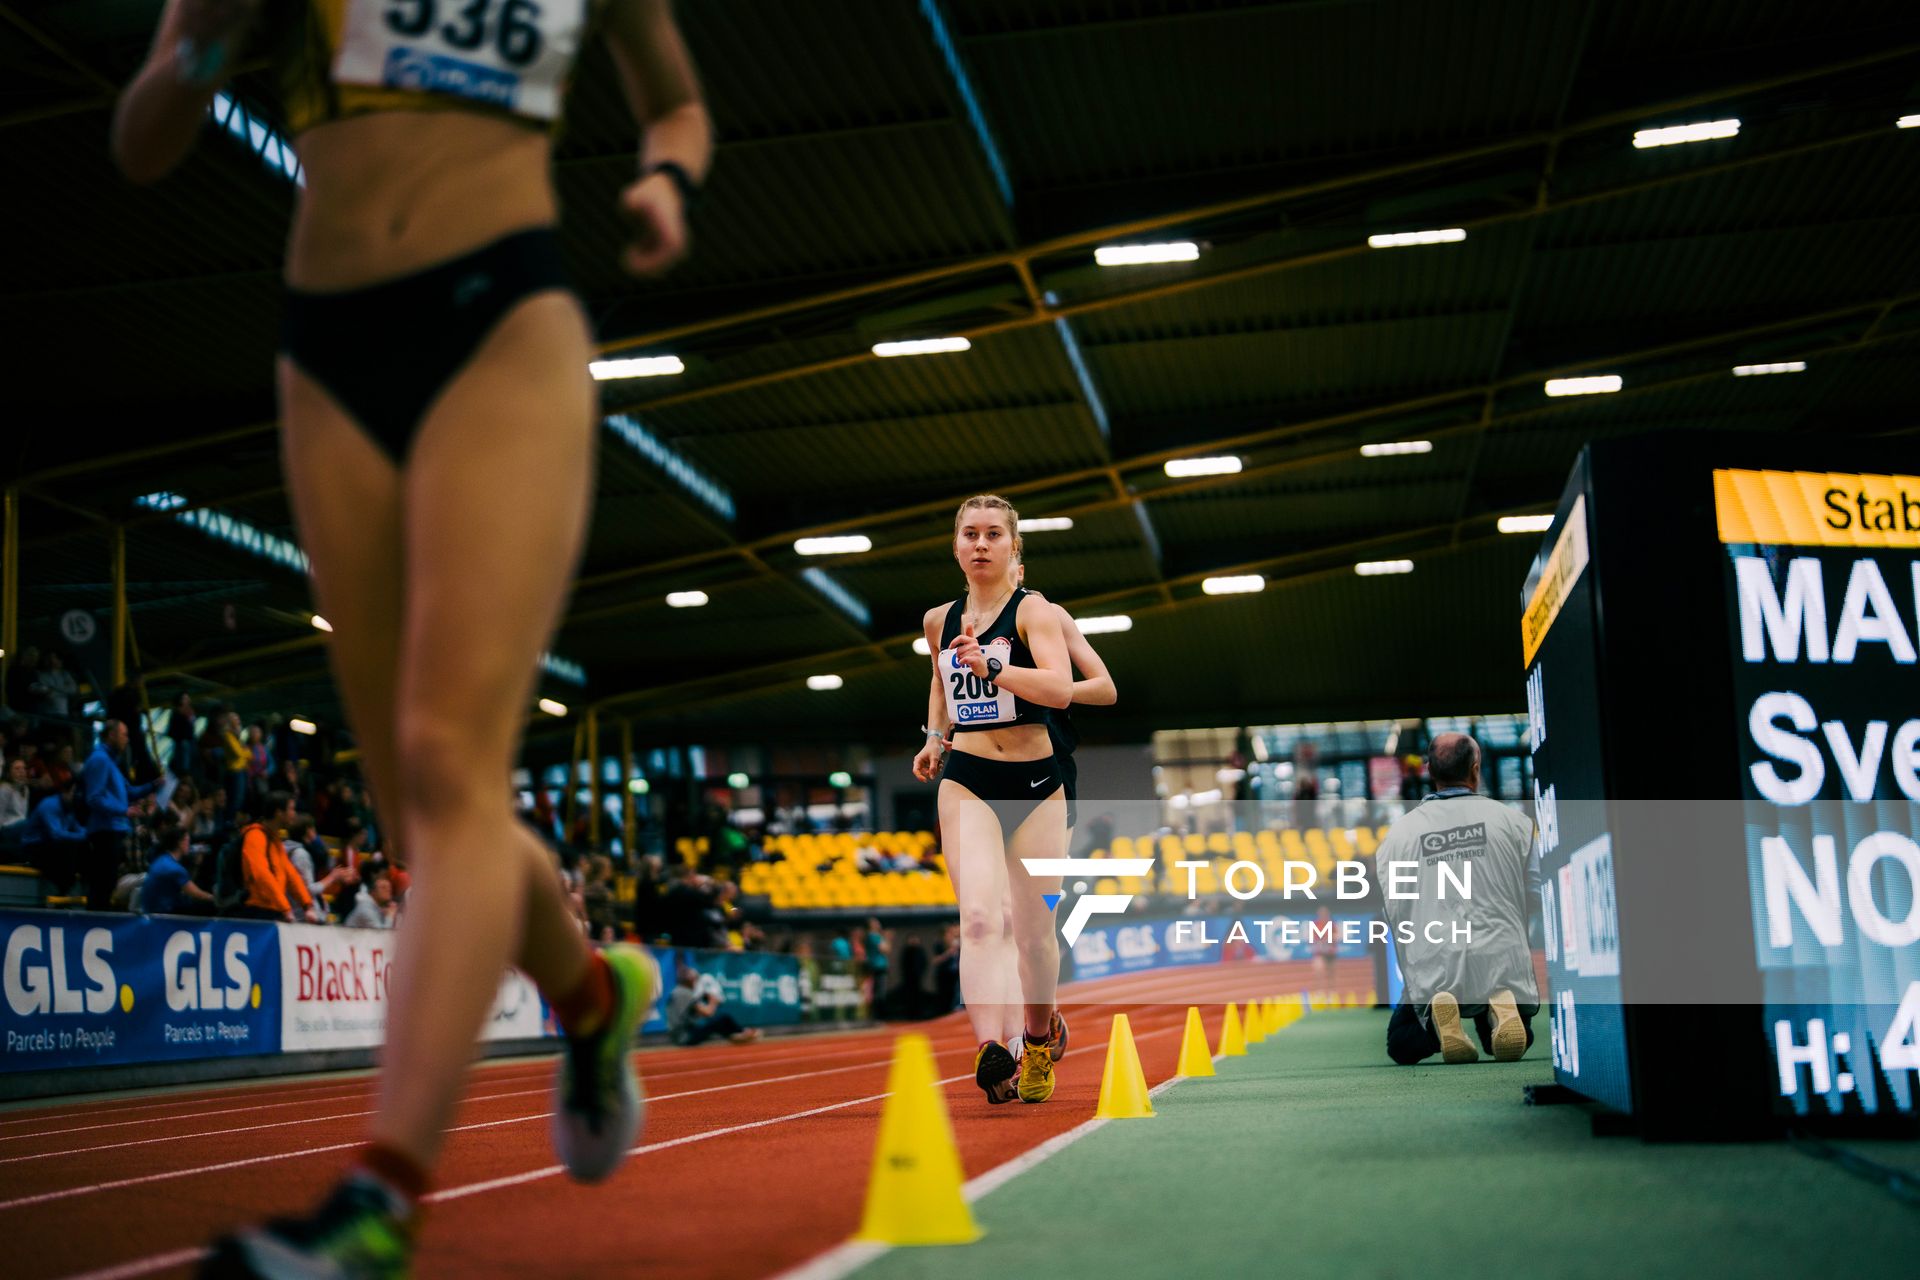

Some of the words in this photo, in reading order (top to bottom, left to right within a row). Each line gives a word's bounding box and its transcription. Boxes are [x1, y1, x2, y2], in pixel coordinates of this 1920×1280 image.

[1734, 556, 1920, 664] MA
[972, 704, 997, 714] PLAN
[1447, 827, 1484, 842] PLAN
[296, 943, 368, 1002] Black
[7, 1029, 55, 1051] Parcels
[59, 1030, 72, 1048] to
[75, 1027, 116, 1053] People
[164, 1023, 202, 1043] Parcels
[205, 1024, 215, 1041] to
[218, 1021, 249, 1044] People
[1774, 1018, 1855, 1096] H:
